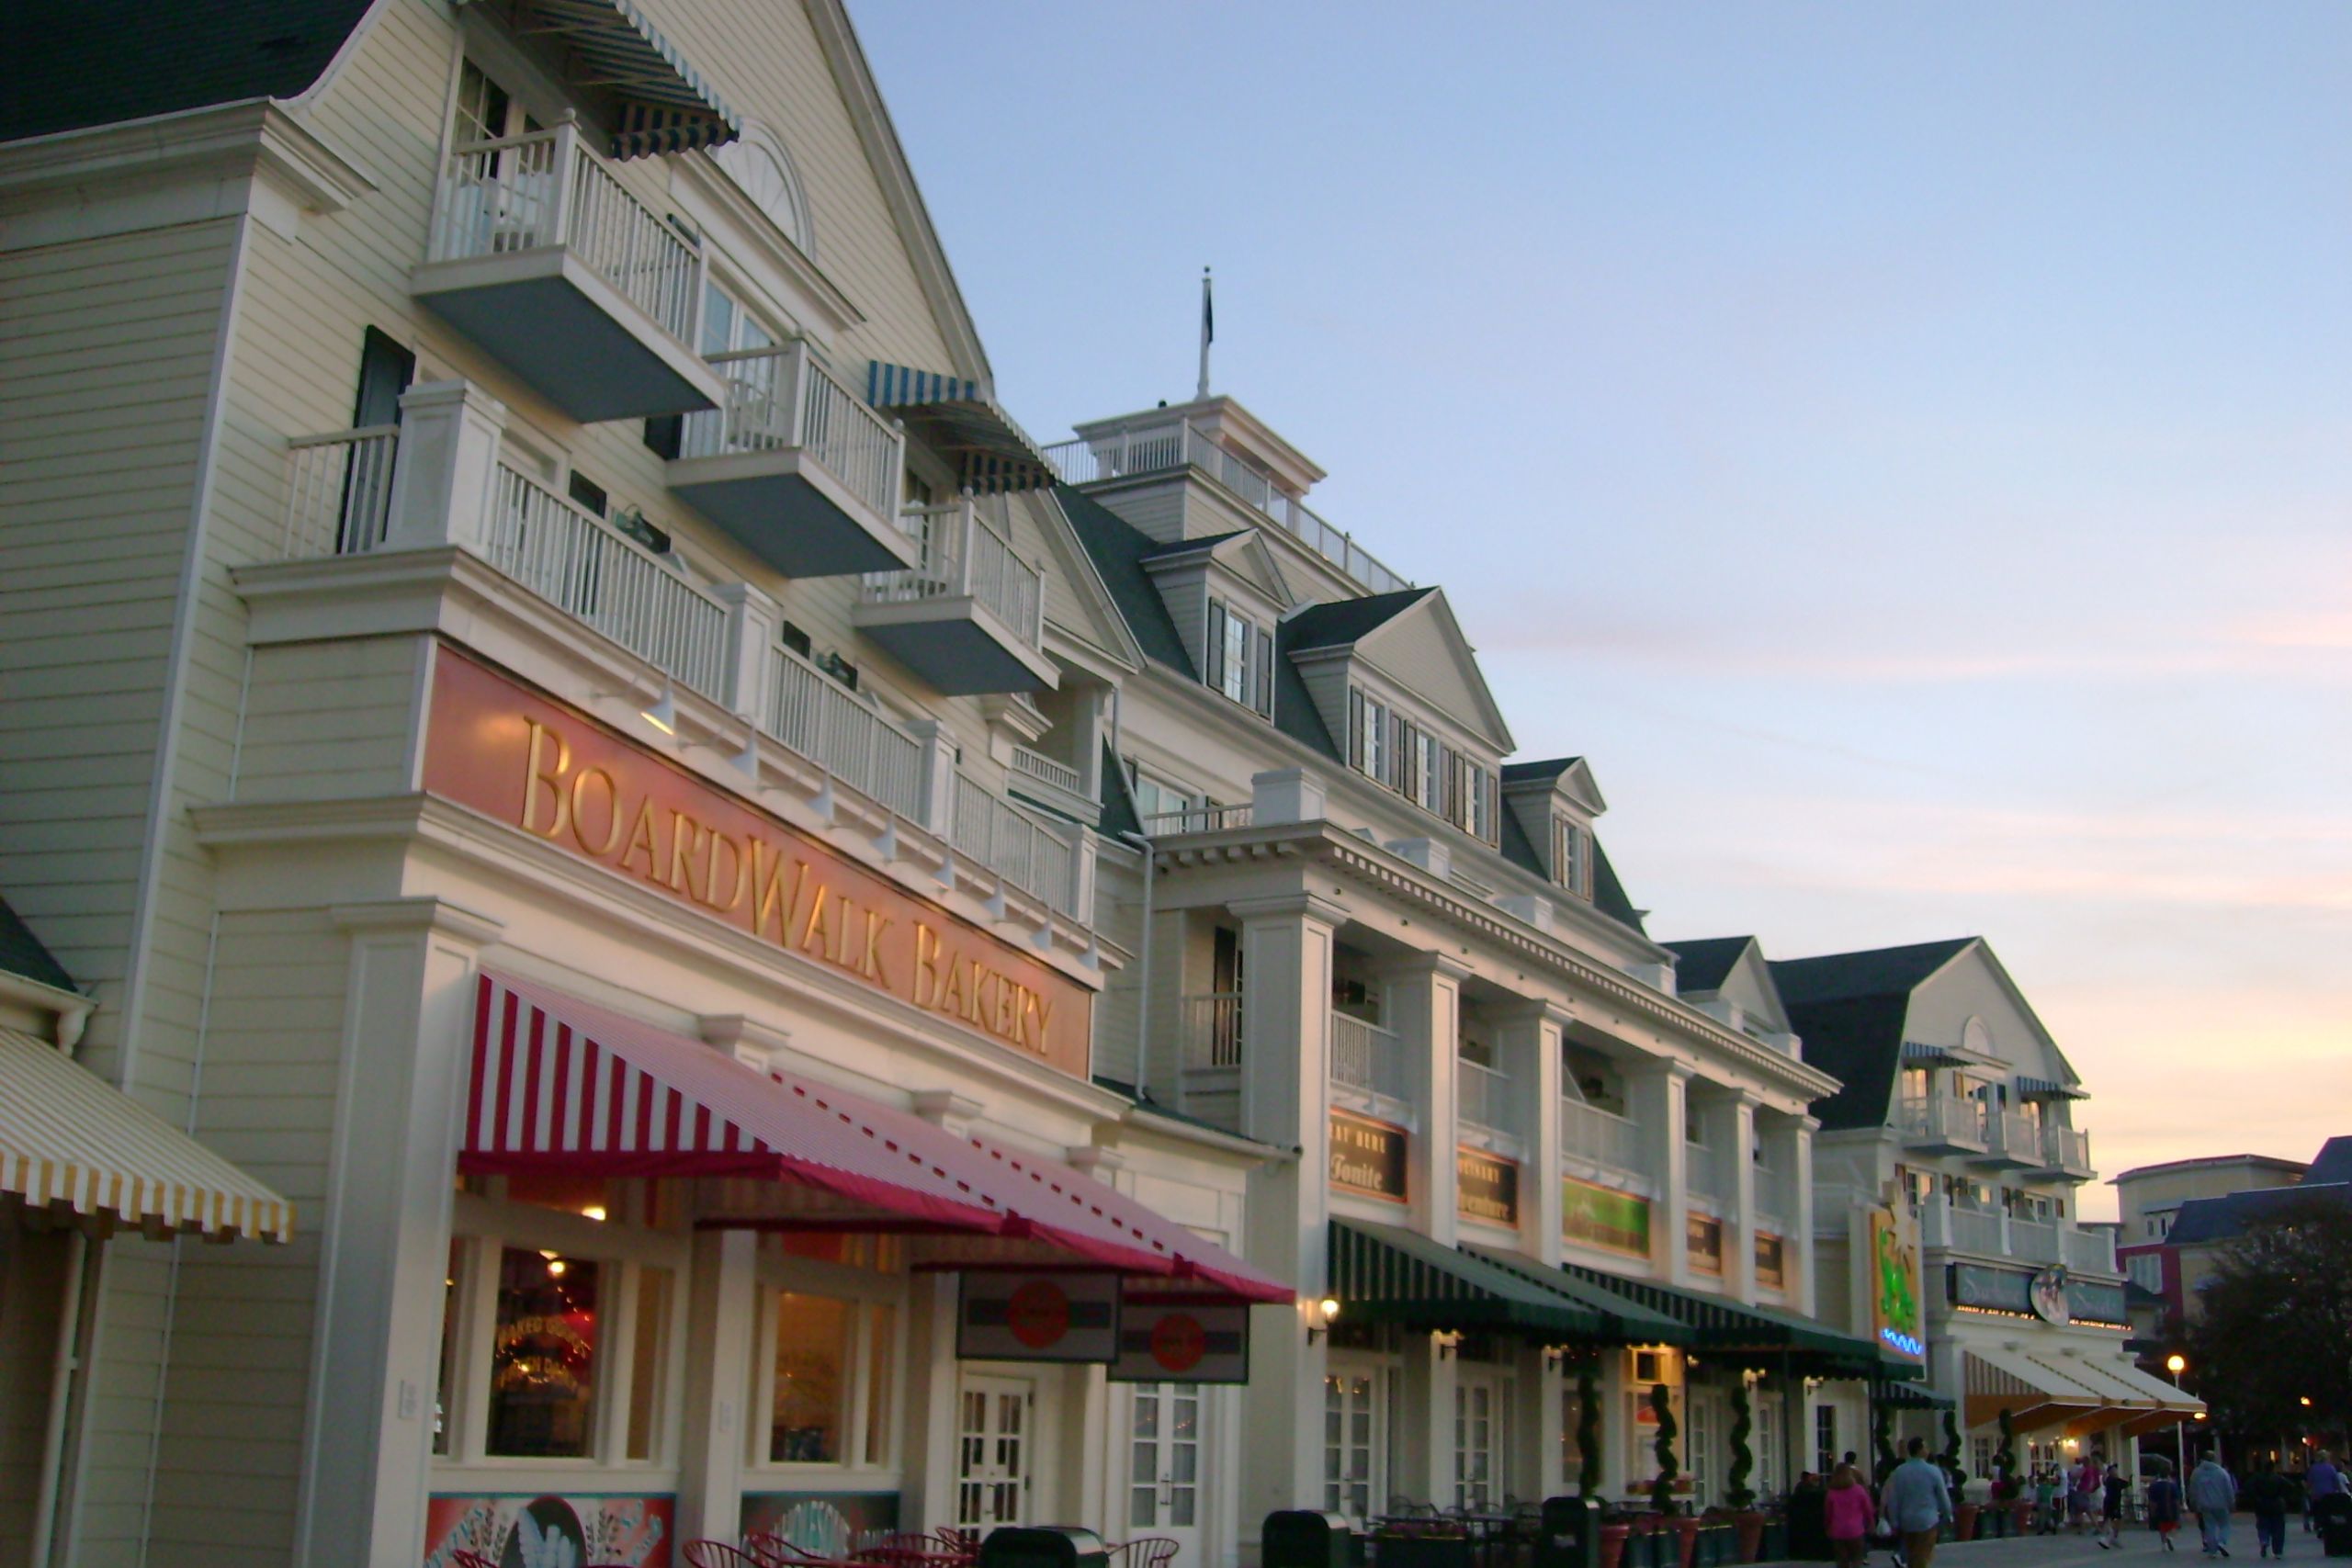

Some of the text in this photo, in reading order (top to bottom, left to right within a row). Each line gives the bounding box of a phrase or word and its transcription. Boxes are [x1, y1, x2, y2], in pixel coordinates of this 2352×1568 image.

[521, 715, 1052, 1057] BOARDWALK BAKERY
[1330, 1153, 1384, 1190] Tonite
